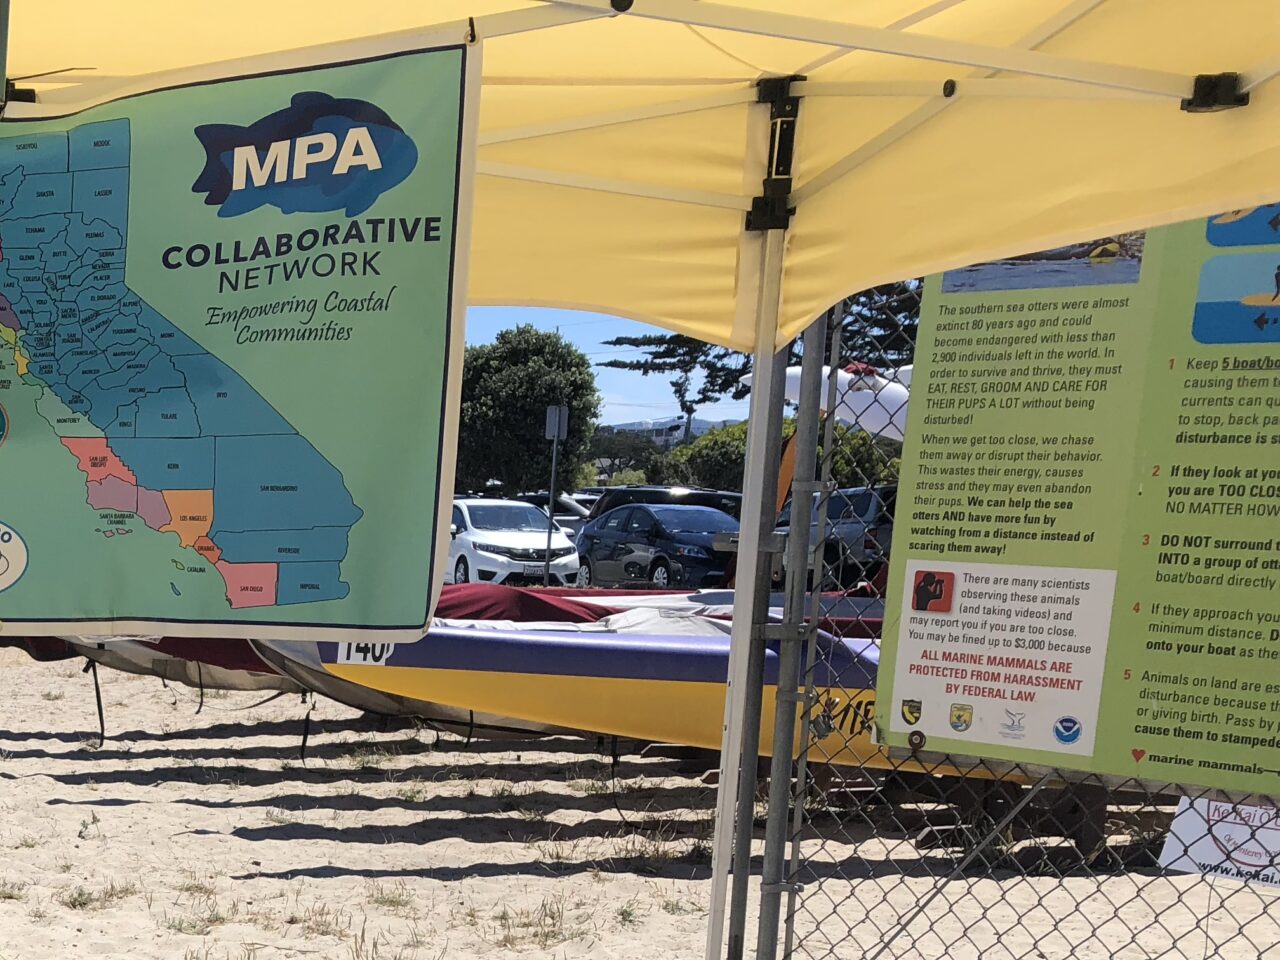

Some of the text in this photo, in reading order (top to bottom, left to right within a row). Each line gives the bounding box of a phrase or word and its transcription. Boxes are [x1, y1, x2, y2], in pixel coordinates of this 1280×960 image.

[232, 127, 382, 190] MPA
[162, 216, 442, 270] COLLABORATIVE
[218, 251, 382, 294] NETWORK
[205, 285, 397, 332] Empowering Coastal
[938, 297, 1129, 315] The southern sea otters were almost
[236, 323, 353, 344] Communities
[927, 379, 1107, 395] EAT, REST, GROOM AND CARE FOR
[926, 397, 1094, 410] THEIR PUPS A LOT without being
[1165, 500, 1280, 516] NO MATTER HOW
[1160, 534, 1272, 550] DO NOT surround
[963, 572, 1089, 590] There are many scientists
[920, 649, 1072, 673] ALL MARINE MAMMALS ARE
[909, 663, 1082, 690] PROTECTED FROM HARASSMENT
[1141, 670, 1261, 692] Animals on land are
[945, 682, 1035, 701] BY FEDERAL LAW
